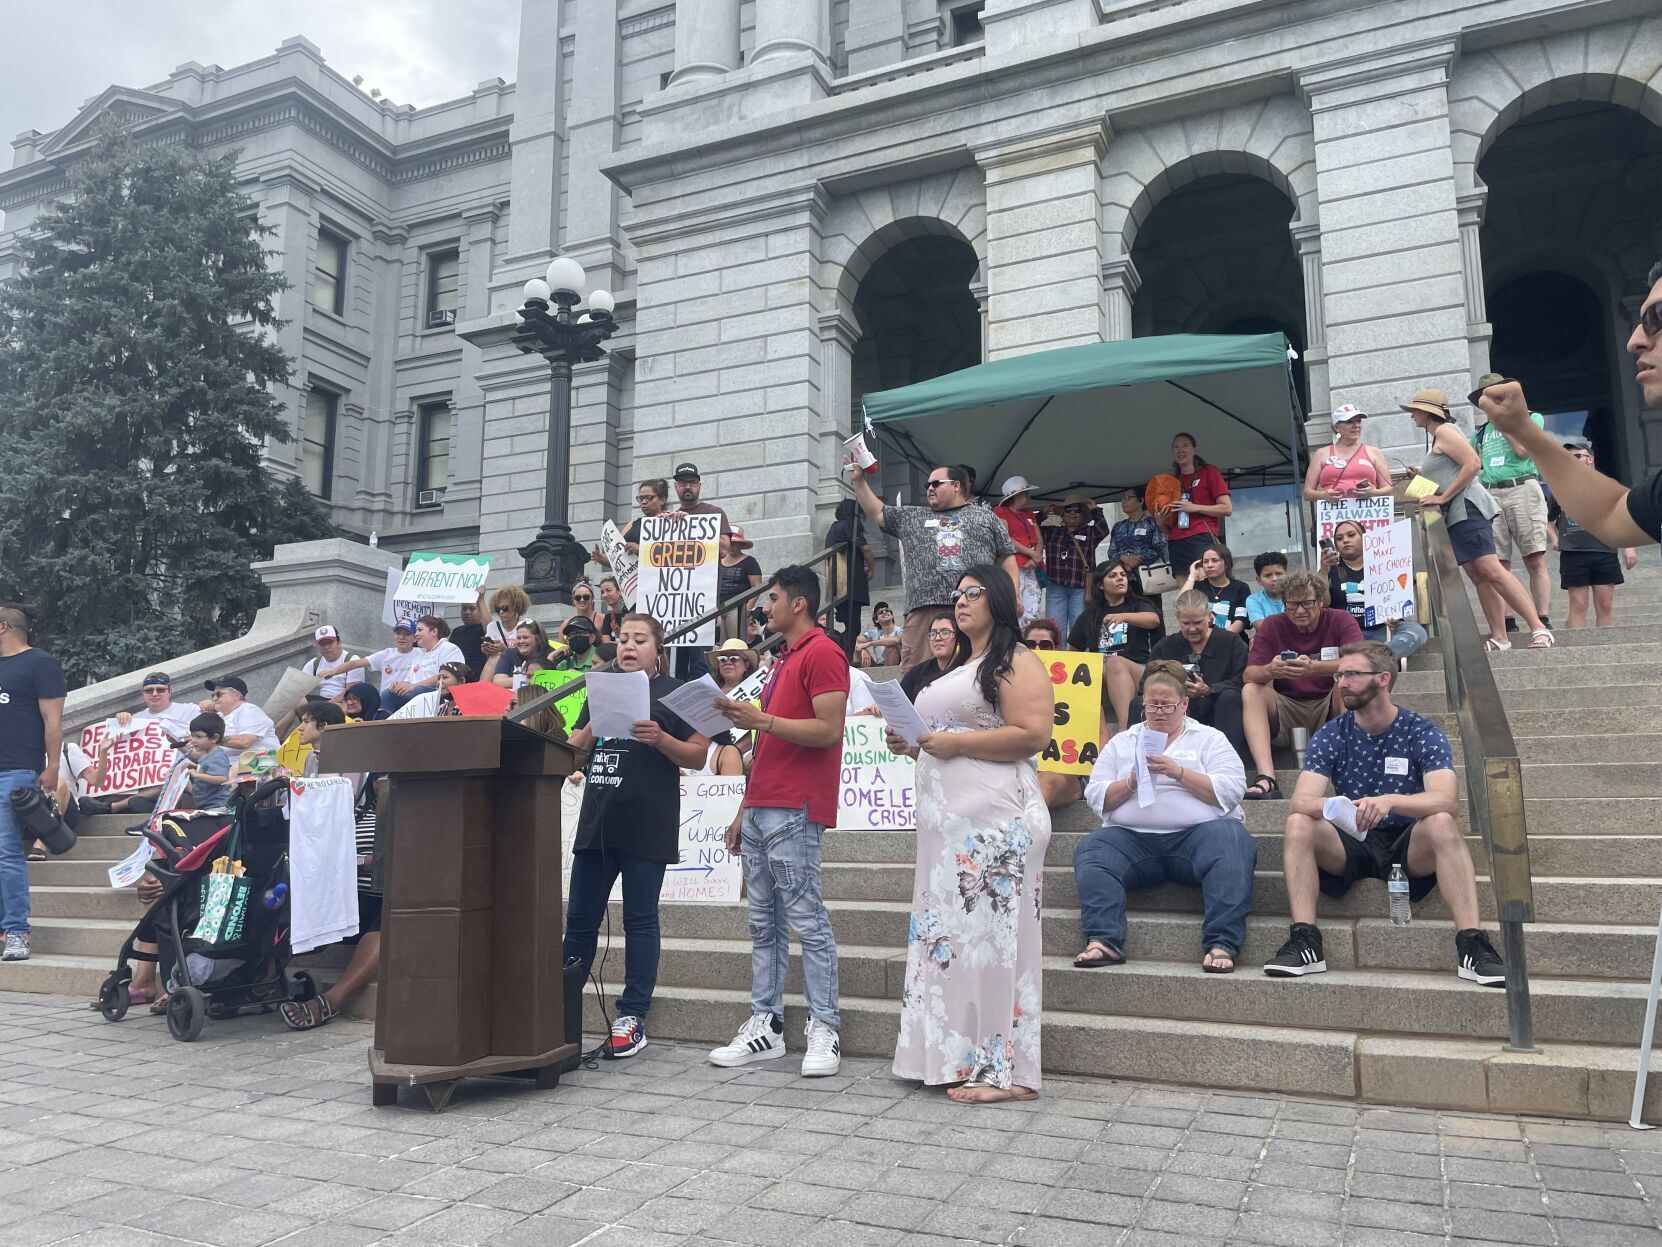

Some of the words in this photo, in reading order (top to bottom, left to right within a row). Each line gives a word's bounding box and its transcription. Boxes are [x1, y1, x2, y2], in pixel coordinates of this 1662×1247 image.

[1321, 500, 1348, 510] THE
[1356, 497, 1389, 509] TIME
[1321, 511, 1332, 520] IS
[1336, 507, 1390, 520] ALWAYS
[642, 516, 718, 542] SUPPRESS
[1364, 530, 1393, 552] DON'T
[649, 540, 707, 567] GREED
[1373, 546, 1397, 559] MAKE
[402, 570, 429, 588] FAIR
[427, 571, 459, 588] RENT
[658, 567, 696, 592] NOT
[1369, 564, 1384, 577] ME
[1370, 579, 1395, 596] FOOD
[403, 609, 411, 618] DE
[645, 592, 705, 618] VOTING
[1376, 600, 1403, 620] RENT
[1049, 661, 1092, 687] SA
[1053, 701, 1070, 726] S
[842, 750, 898, 766] OUSING
[1042, 738, 1099, 766] ASA
[841, 766, 862, 785] OT
[871, 766, 886, 786] A
[697, 782, 745, 799] GOING
[842, 787, 913, 808] OMELE
[673, 876, 699, 888] WILL
[678, 886, 730, 899] HOMES!
[224, 885, 248, 941] BEYOND
